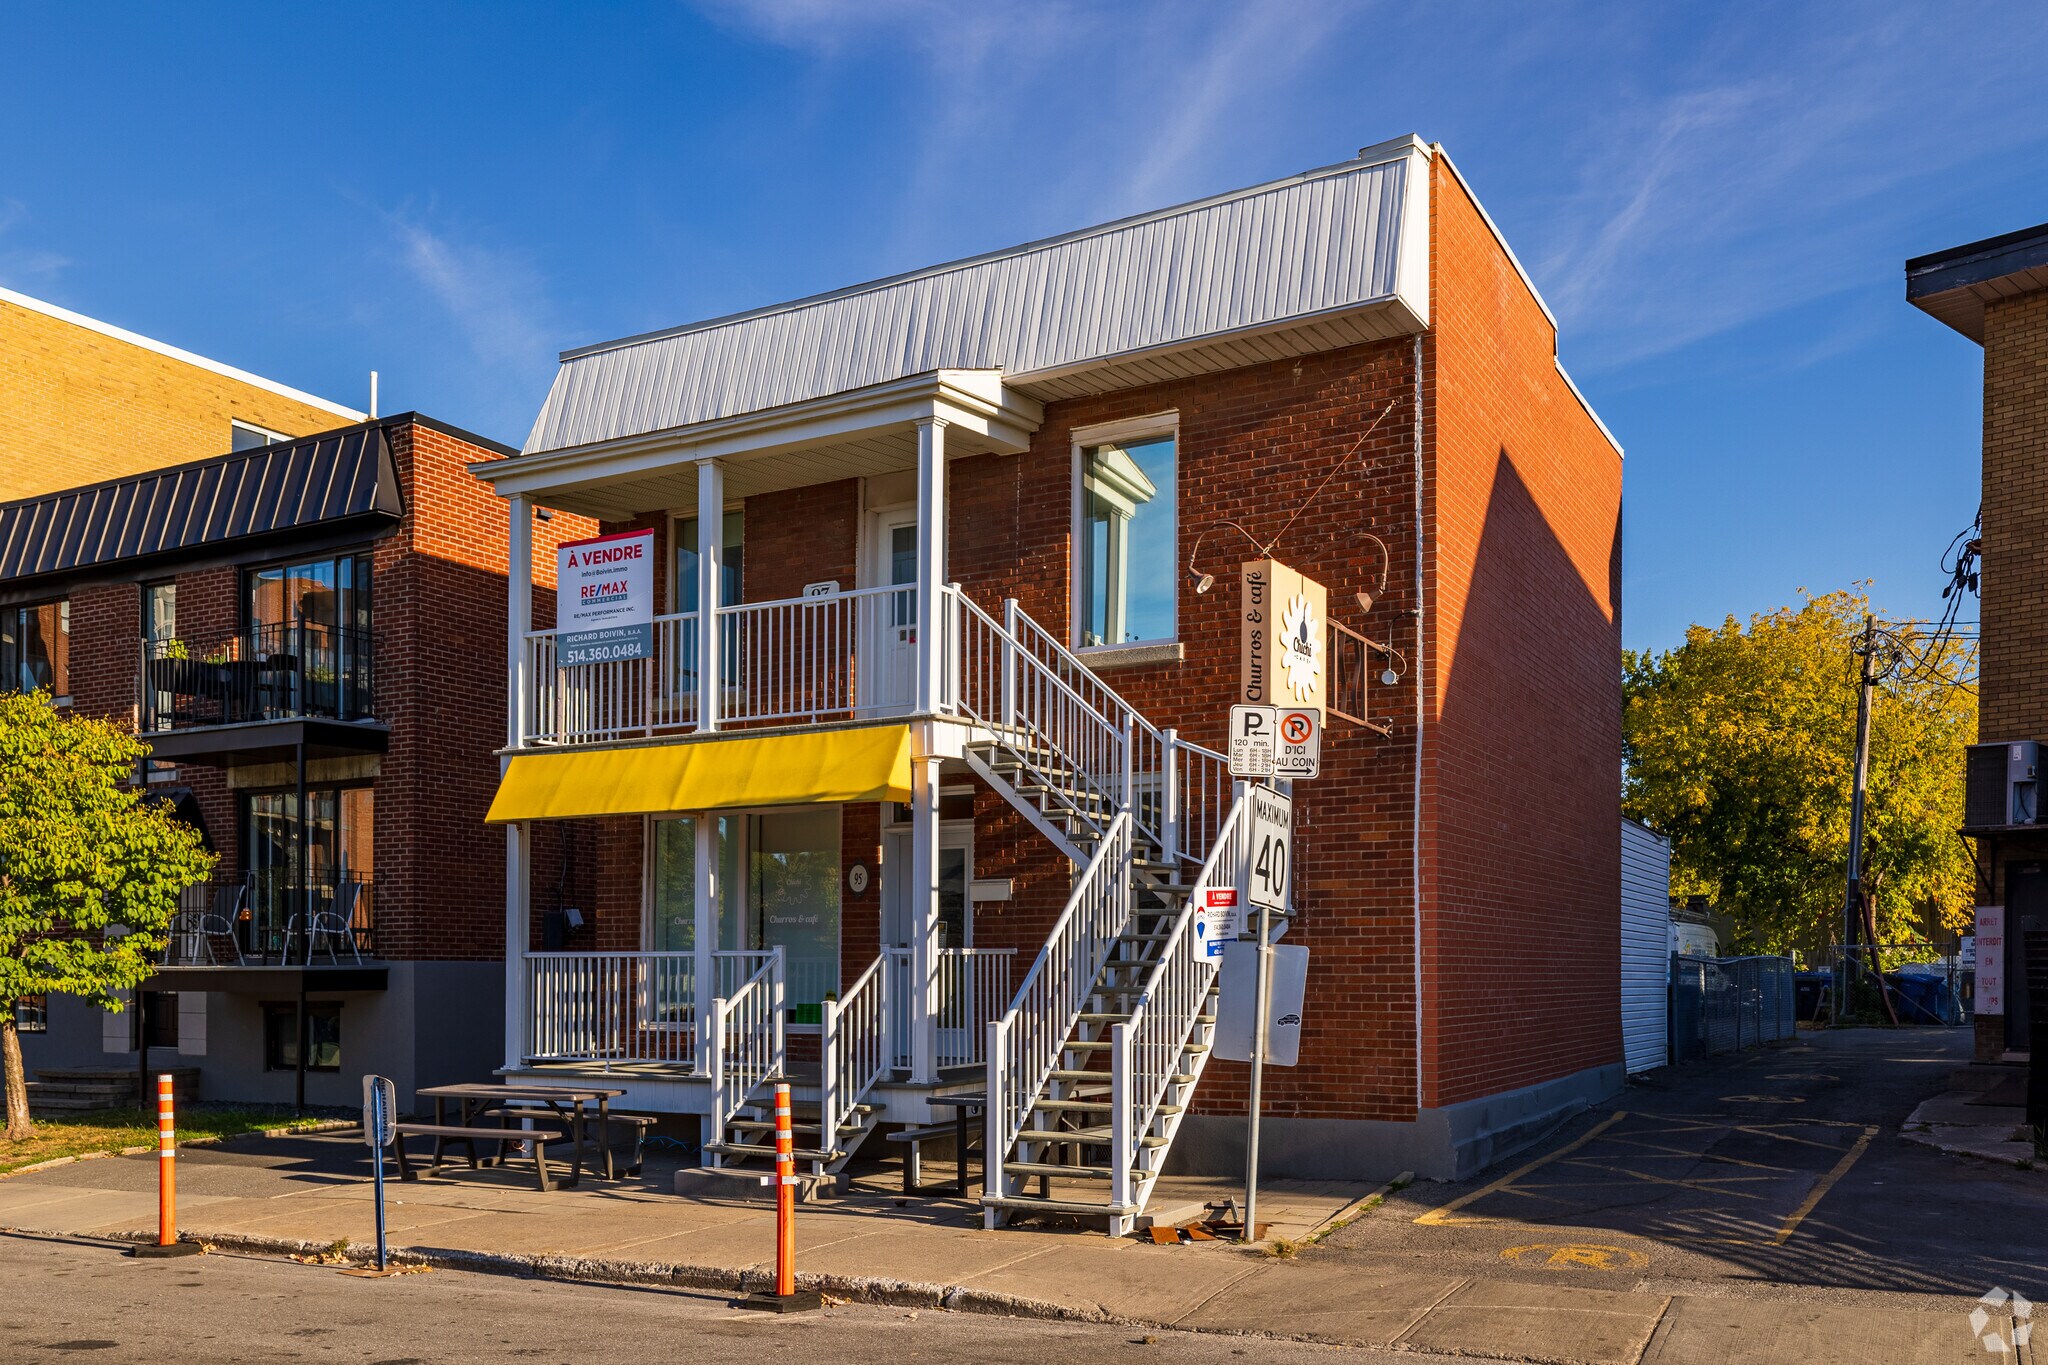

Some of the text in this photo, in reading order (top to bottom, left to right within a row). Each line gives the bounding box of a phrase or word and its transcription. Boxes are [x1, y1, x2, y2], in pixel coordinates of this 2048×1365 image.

[568, 544, 642, 568] À VENDRE
[581, 580, 628, 598] RE/MAX
[582, 595, 627, 605] COMMERCIAL
[574, 611, 593, 619] RE/MAX
[592, 607, 625, 617] PERFORMANCE
[567, 632, 598, 643] RICHARD
[600, 629, 626, 638] BOIVIN,
[1246, 570, 1266, 702] Churros & café
[567, 642, 642, 663] 514.360.0484
[1244, 712, 1263, 737] P
[1285, 745, 1306, 755] D'ICI
[1276, 757, 1315, 767] AU COIN
[1257, 799, 1288, 829] MAXIMUM
[1255, 834, 1285, 897] 40
[854, 873, 862, 885] 95
[1216, 892, 1232, 900] VENDRE
[769, 915, 796, 924] Churros
[798, 915, 804, 923] &
[1976, 938, 2002, 946] INTERDIT
[1985, 958, 1993, 966] EN
[1981, 977, 1996, 986] TOUT
